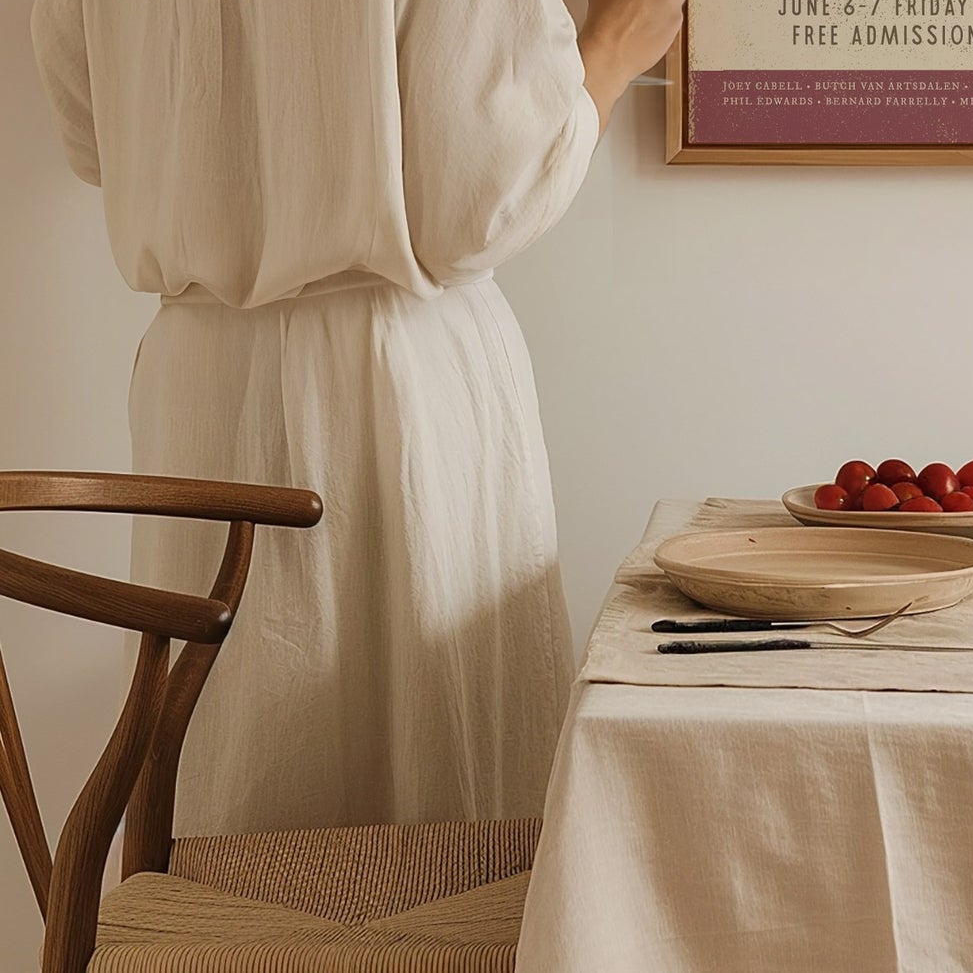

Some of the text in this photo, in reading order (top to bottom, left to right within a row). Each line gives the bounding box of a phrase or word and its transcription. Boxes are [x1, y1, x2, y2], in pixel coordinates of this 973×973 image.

[792, 25, 838, 45] FREE
[722, 81, 752, 92] JOEY
[755, 81, 803, 91] CABELL
[815, 81, 856, 91] BUTCH
[861, 81, 884, 91] VAN
[888, 81, 960, 91] ARTSDALEN
[723, 97, 752, 106] PHIL
[757, 96, 814, 106] EDWARDS
[825, 96, 882, 106] BERNARD
[886, 96, 948, 106] FARRELLY
